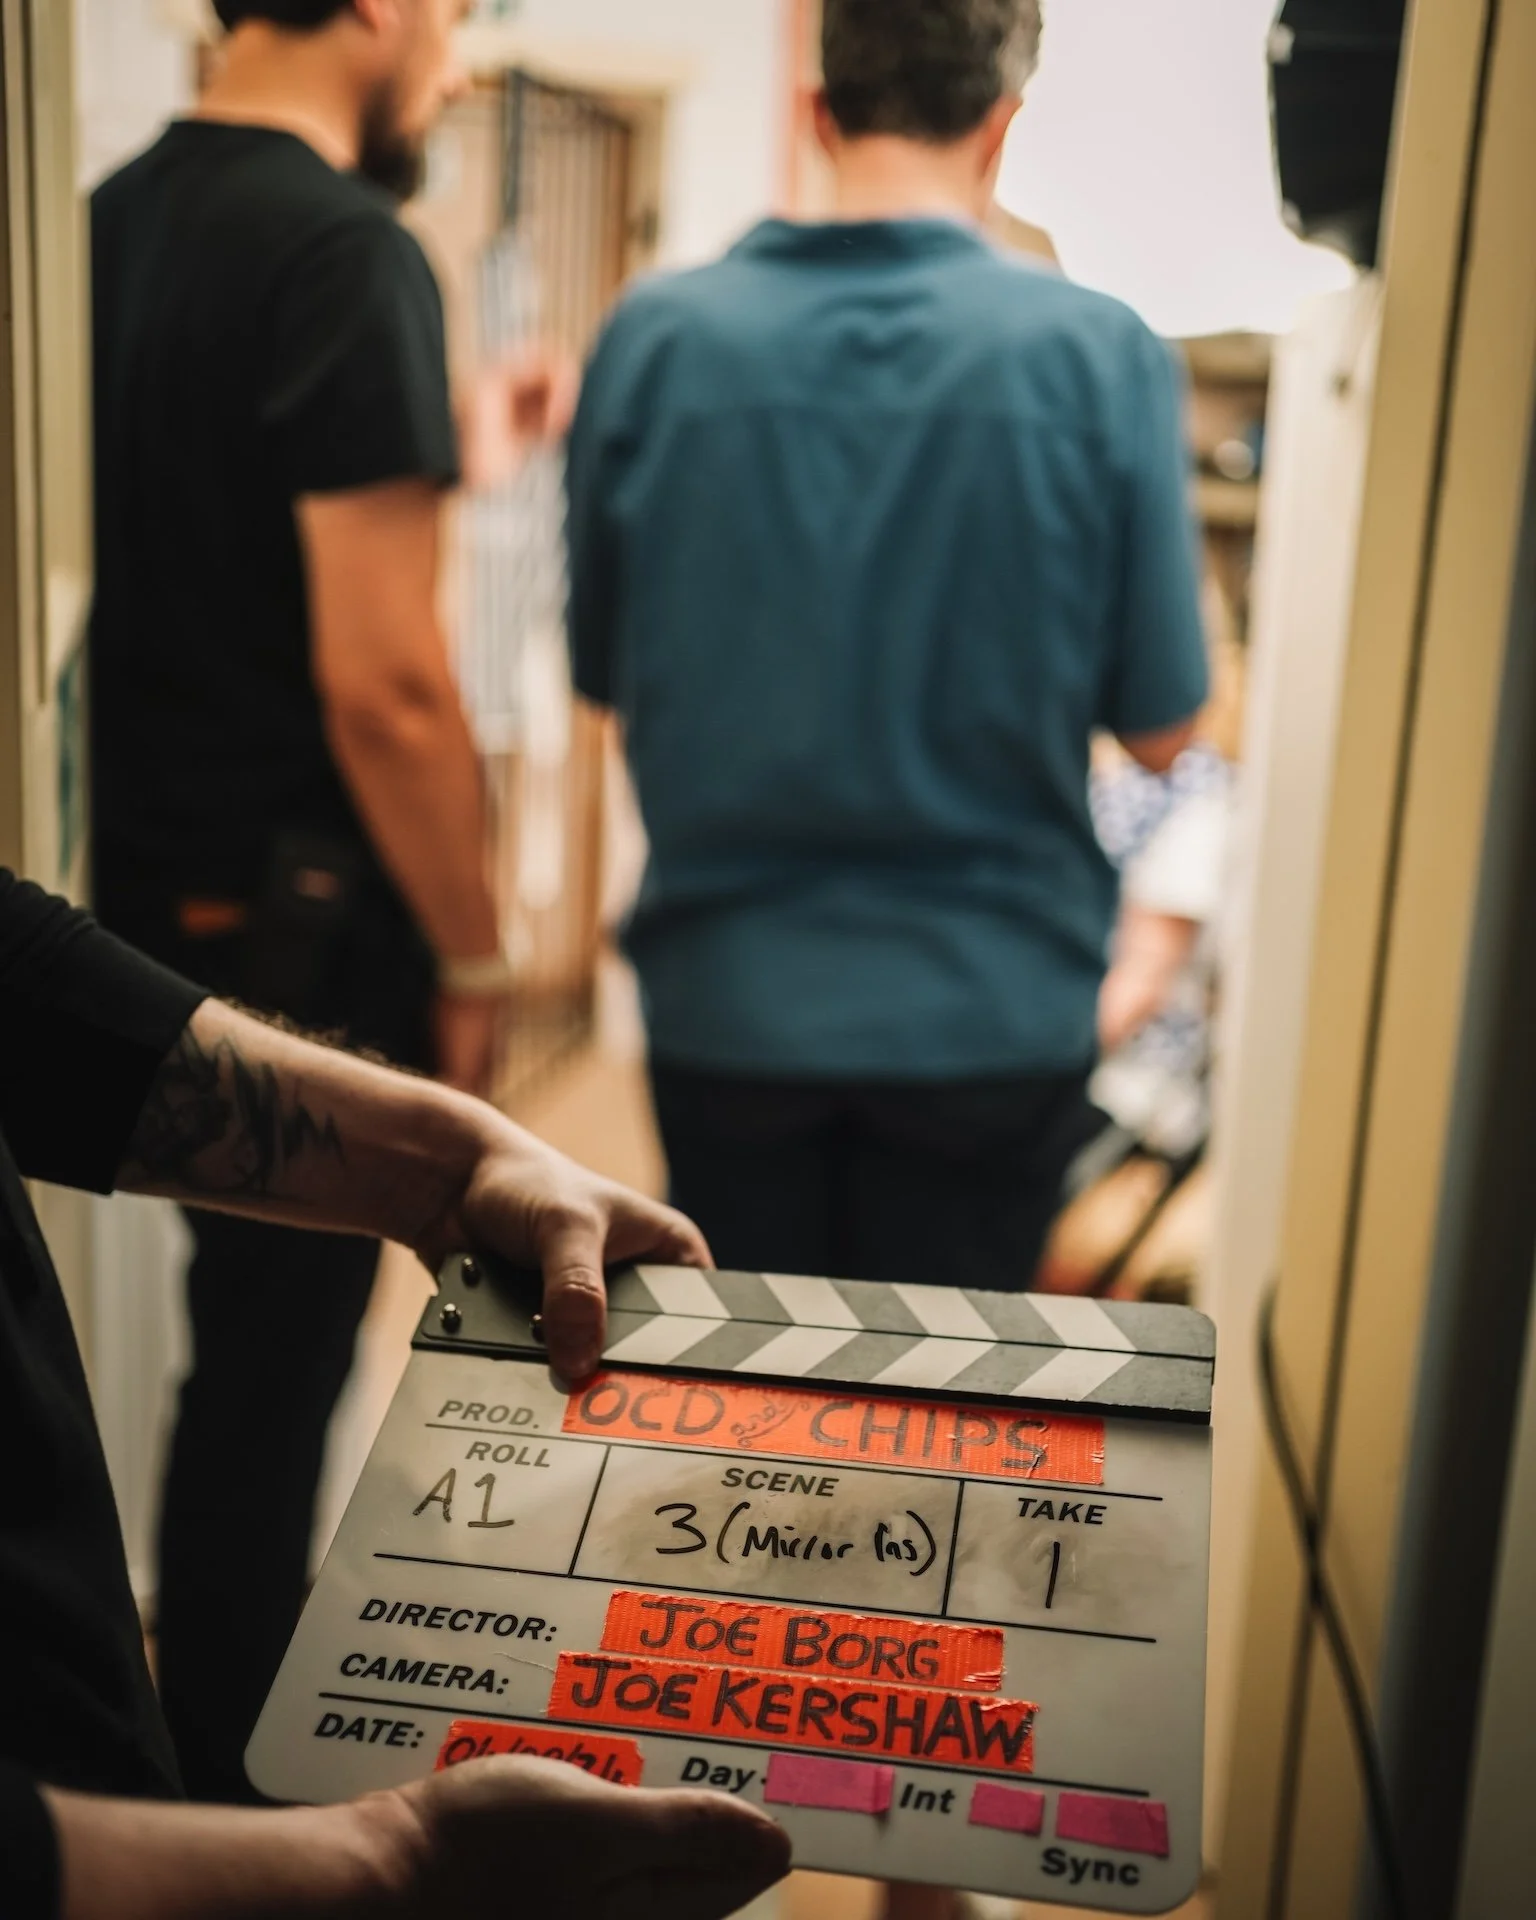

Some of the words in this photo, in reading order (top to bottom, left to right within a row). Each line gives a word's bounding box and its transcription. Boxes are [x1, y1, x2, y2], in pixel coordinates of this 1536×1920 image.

[438, 1400, 540, 1430] PROD.
[579, 1381, 725, 1436] OCD
[810, 1400, 1051, 1471] CHIPS
[465, 1441, 552, 1468] ROLL
[412, 1467, 515, 1529] A1
[721, 1467, 840, 1498] SCENE
[655, 1503, 707, 1555] 3
[1018, 1497, 1108, 1526] TAKE
[1045, 1541, 1061, 1609] 1
[359, 1598, 558, 1642] DIRECTOR:
[639, 1600, 760, 1657] JOE
[781, 1615, 940, 1681] BORG
[339, 1652, 509, 1695] CAMERA:
[313, 1712, 426, 1749] DATE:
[571, 1657, 699, 1721] JOE
[710, 1669, 1036, 1765] KERSHAW
[680, 1756, 757, 1794] Day
[899, 1783, 956, 1814] Int
[1041, 1846, 1140, 1886] Sync
